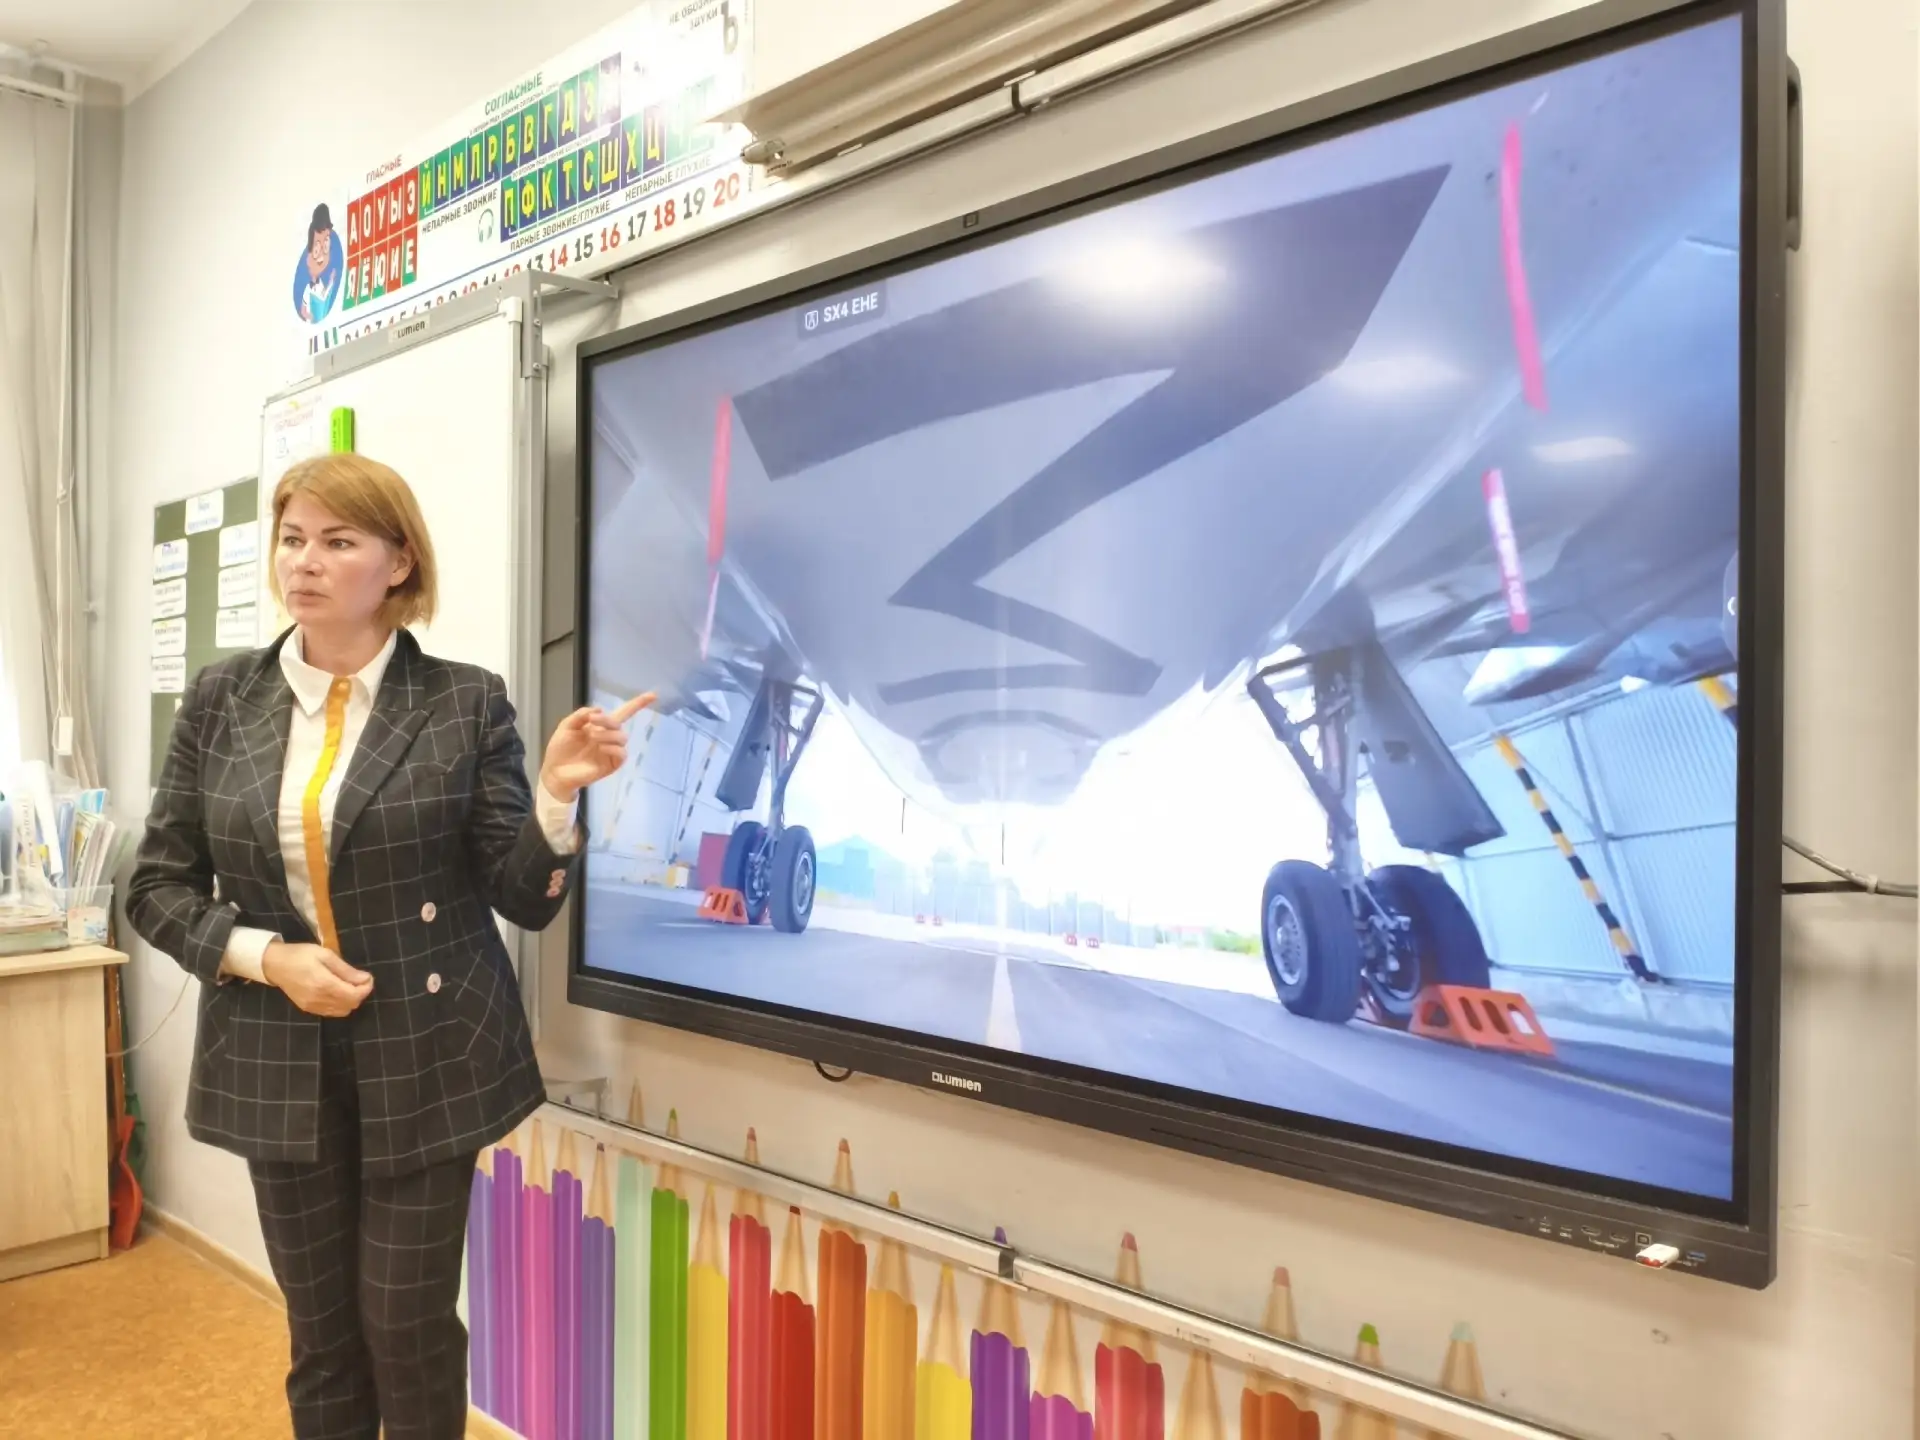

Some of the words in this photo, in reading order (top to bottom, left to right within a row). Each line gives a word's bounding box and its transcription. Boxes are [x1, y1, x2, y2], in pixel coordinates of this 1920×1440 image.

[484, 71, 544, 116] СОГЛАСНЫЕ
[365, 153, 403, 184] ГЛАСНЫЕ
[624, 171, 674, 202] НЕПАРНЫЕ
[422, 207, 462, 235] НЕПАРНЫЕ
[550, 243, 568, 273] 14
[574, 232, 594, 263] 15
[600, 222, 621, 253] 16
[627, 209, 647, 242] 17
[653, 197, 676, 232] 18
[683, 186, 706, 221] 19
[510, 230, 541, 253] ПАРНЫЕ
[823, 301, 849, 323] SX4
[852, 291, 879, 315] EHE
